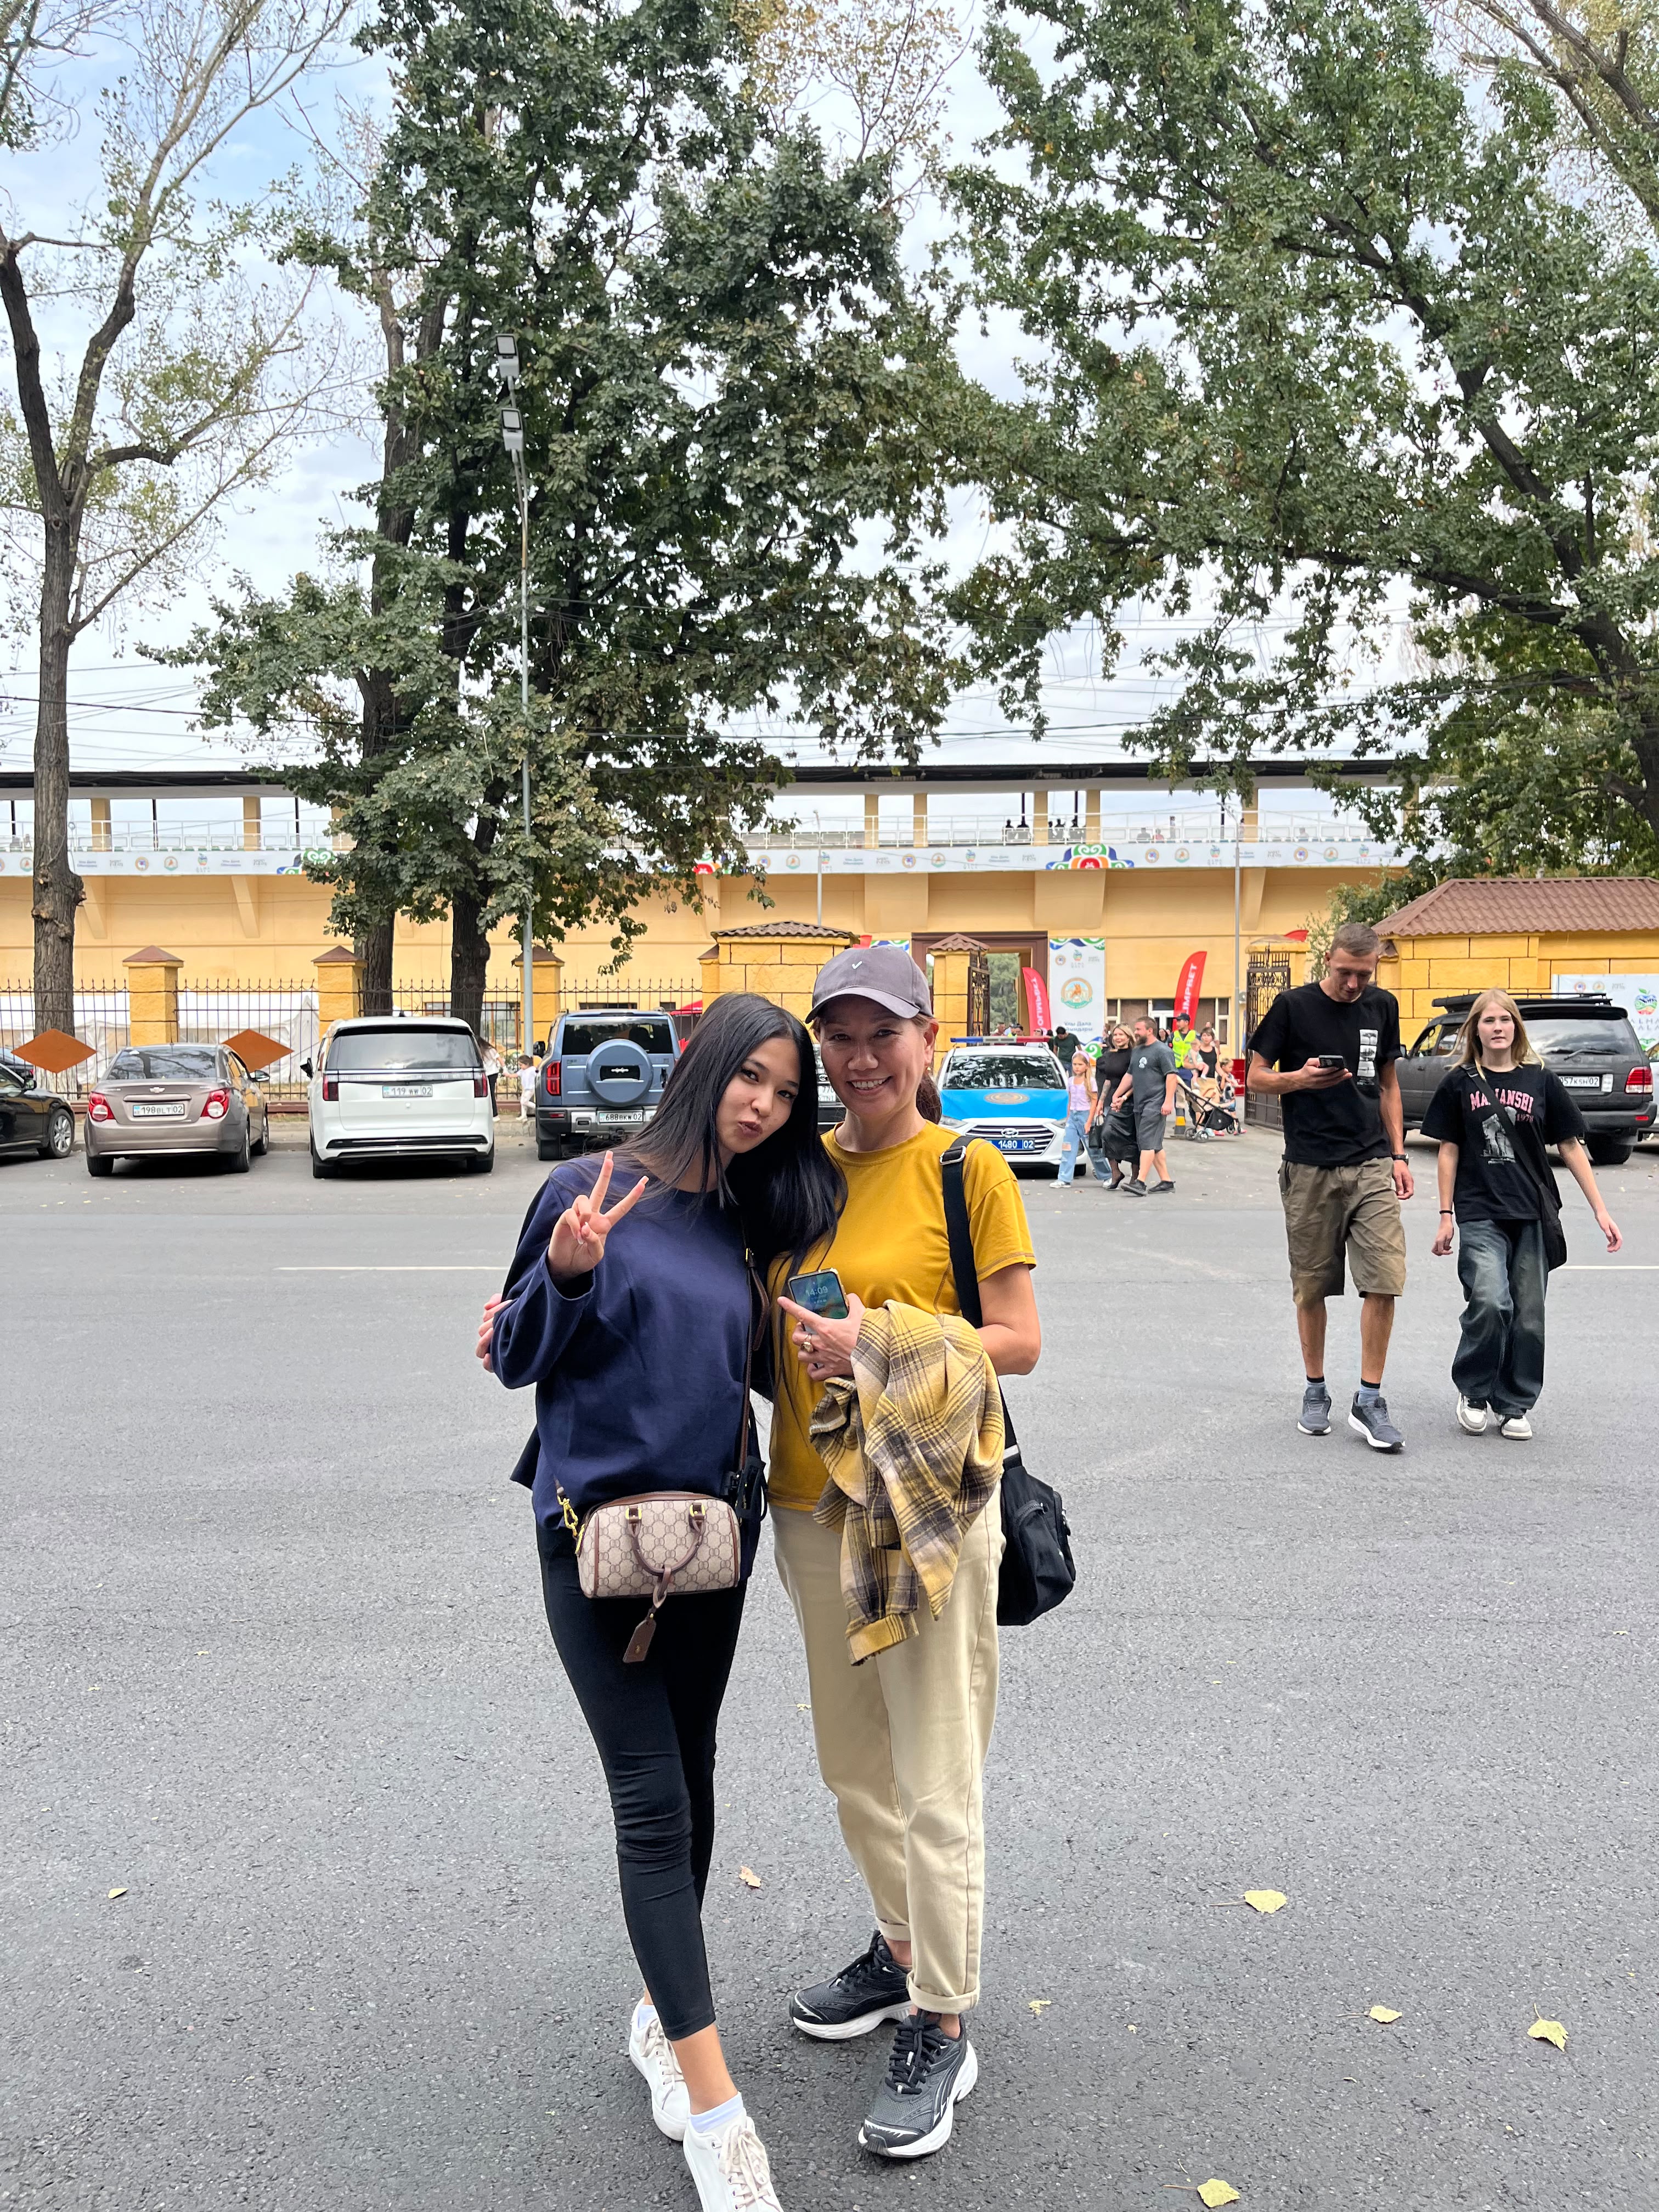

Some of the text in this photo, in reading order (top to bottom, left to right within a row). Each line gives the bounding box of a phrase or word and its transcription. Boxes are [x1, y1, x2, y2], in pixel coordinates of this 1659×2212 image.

[1589, 1077, 1599, 1085] 02
[998, 1140, 1034, 1148] 1480 02
[805, 1285, 828, 1297] 14:09
